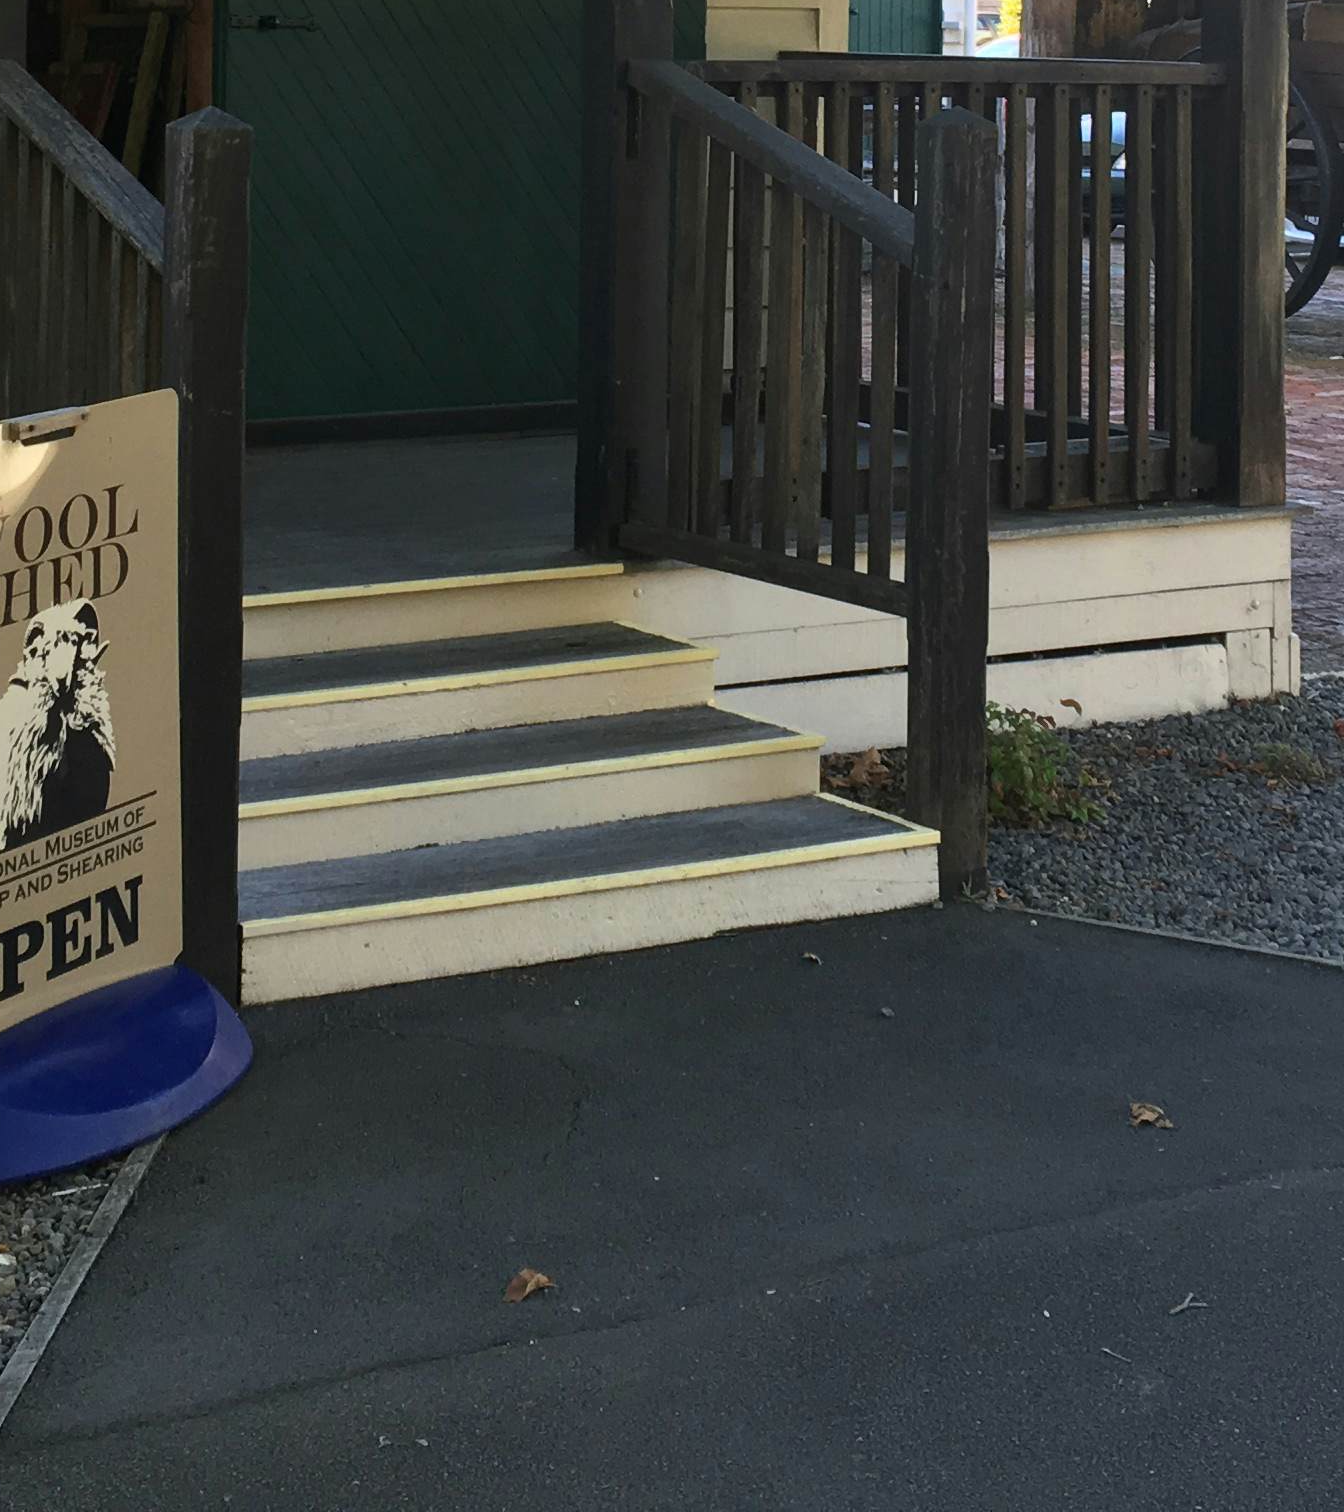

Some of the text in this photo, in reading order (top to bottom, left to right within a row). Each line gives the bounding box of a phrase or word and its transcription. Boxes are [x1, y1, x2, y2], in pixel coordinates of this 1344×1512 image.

[45, 816, 119, 858] MUSEUM
[123, 806, 146, 829] OF
[14, 873, 53, 903] AND
[57, 836, 144, 884] SHEARING
